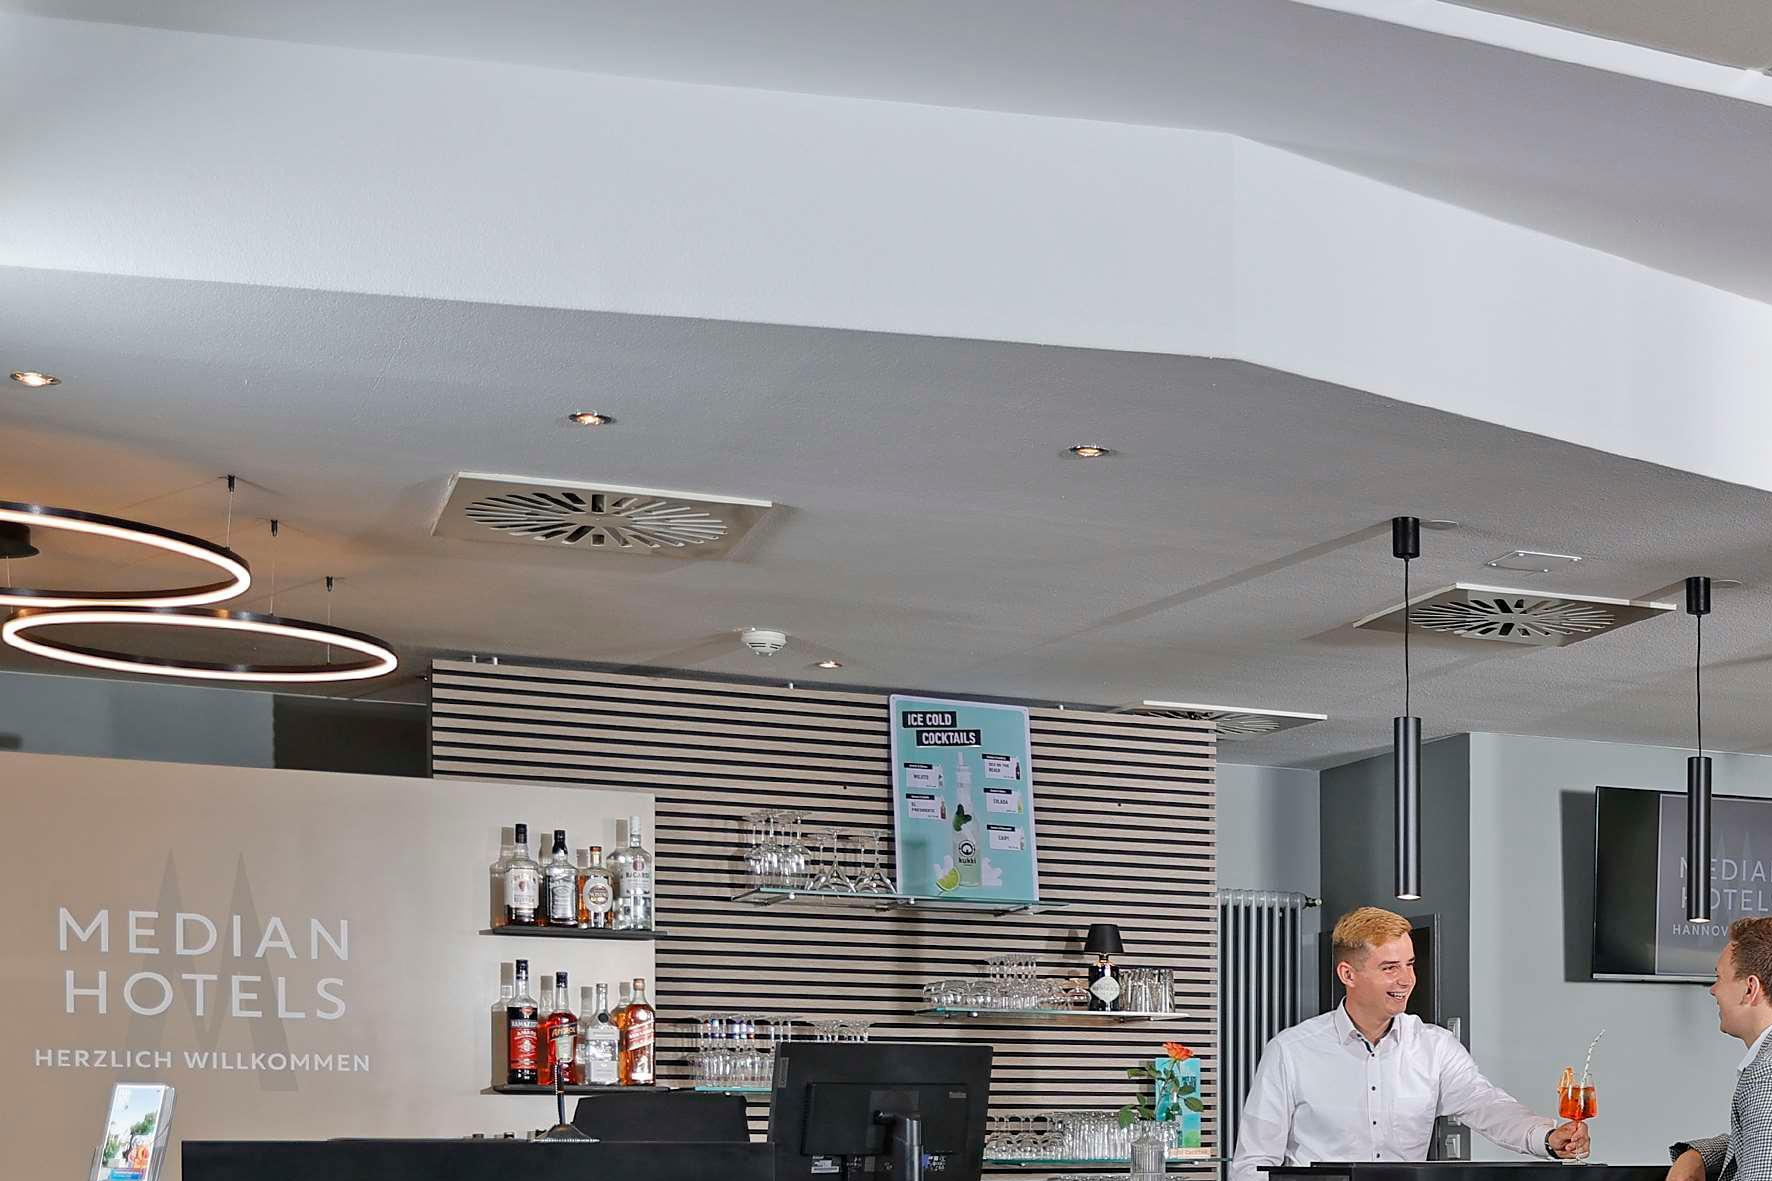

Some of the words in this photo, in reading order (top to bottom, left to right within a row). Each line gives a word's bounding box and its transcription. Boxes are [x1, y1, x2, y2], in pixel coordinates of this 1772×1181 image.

[907, 713, 924, 726] ICE
[926, 713, 952, 726] COLD
[922, 731, 976, 745] COCKTAILS
[58, 906, 349, 960] MEDIAN
[1672, 924, 1729, 937] HANNOV
[65, 969, 347, 1020] HOTELS
[34, 1048, 173, 1069] HERZLICH
[183, 1050, 371, 1072] WILLKOMMEN
